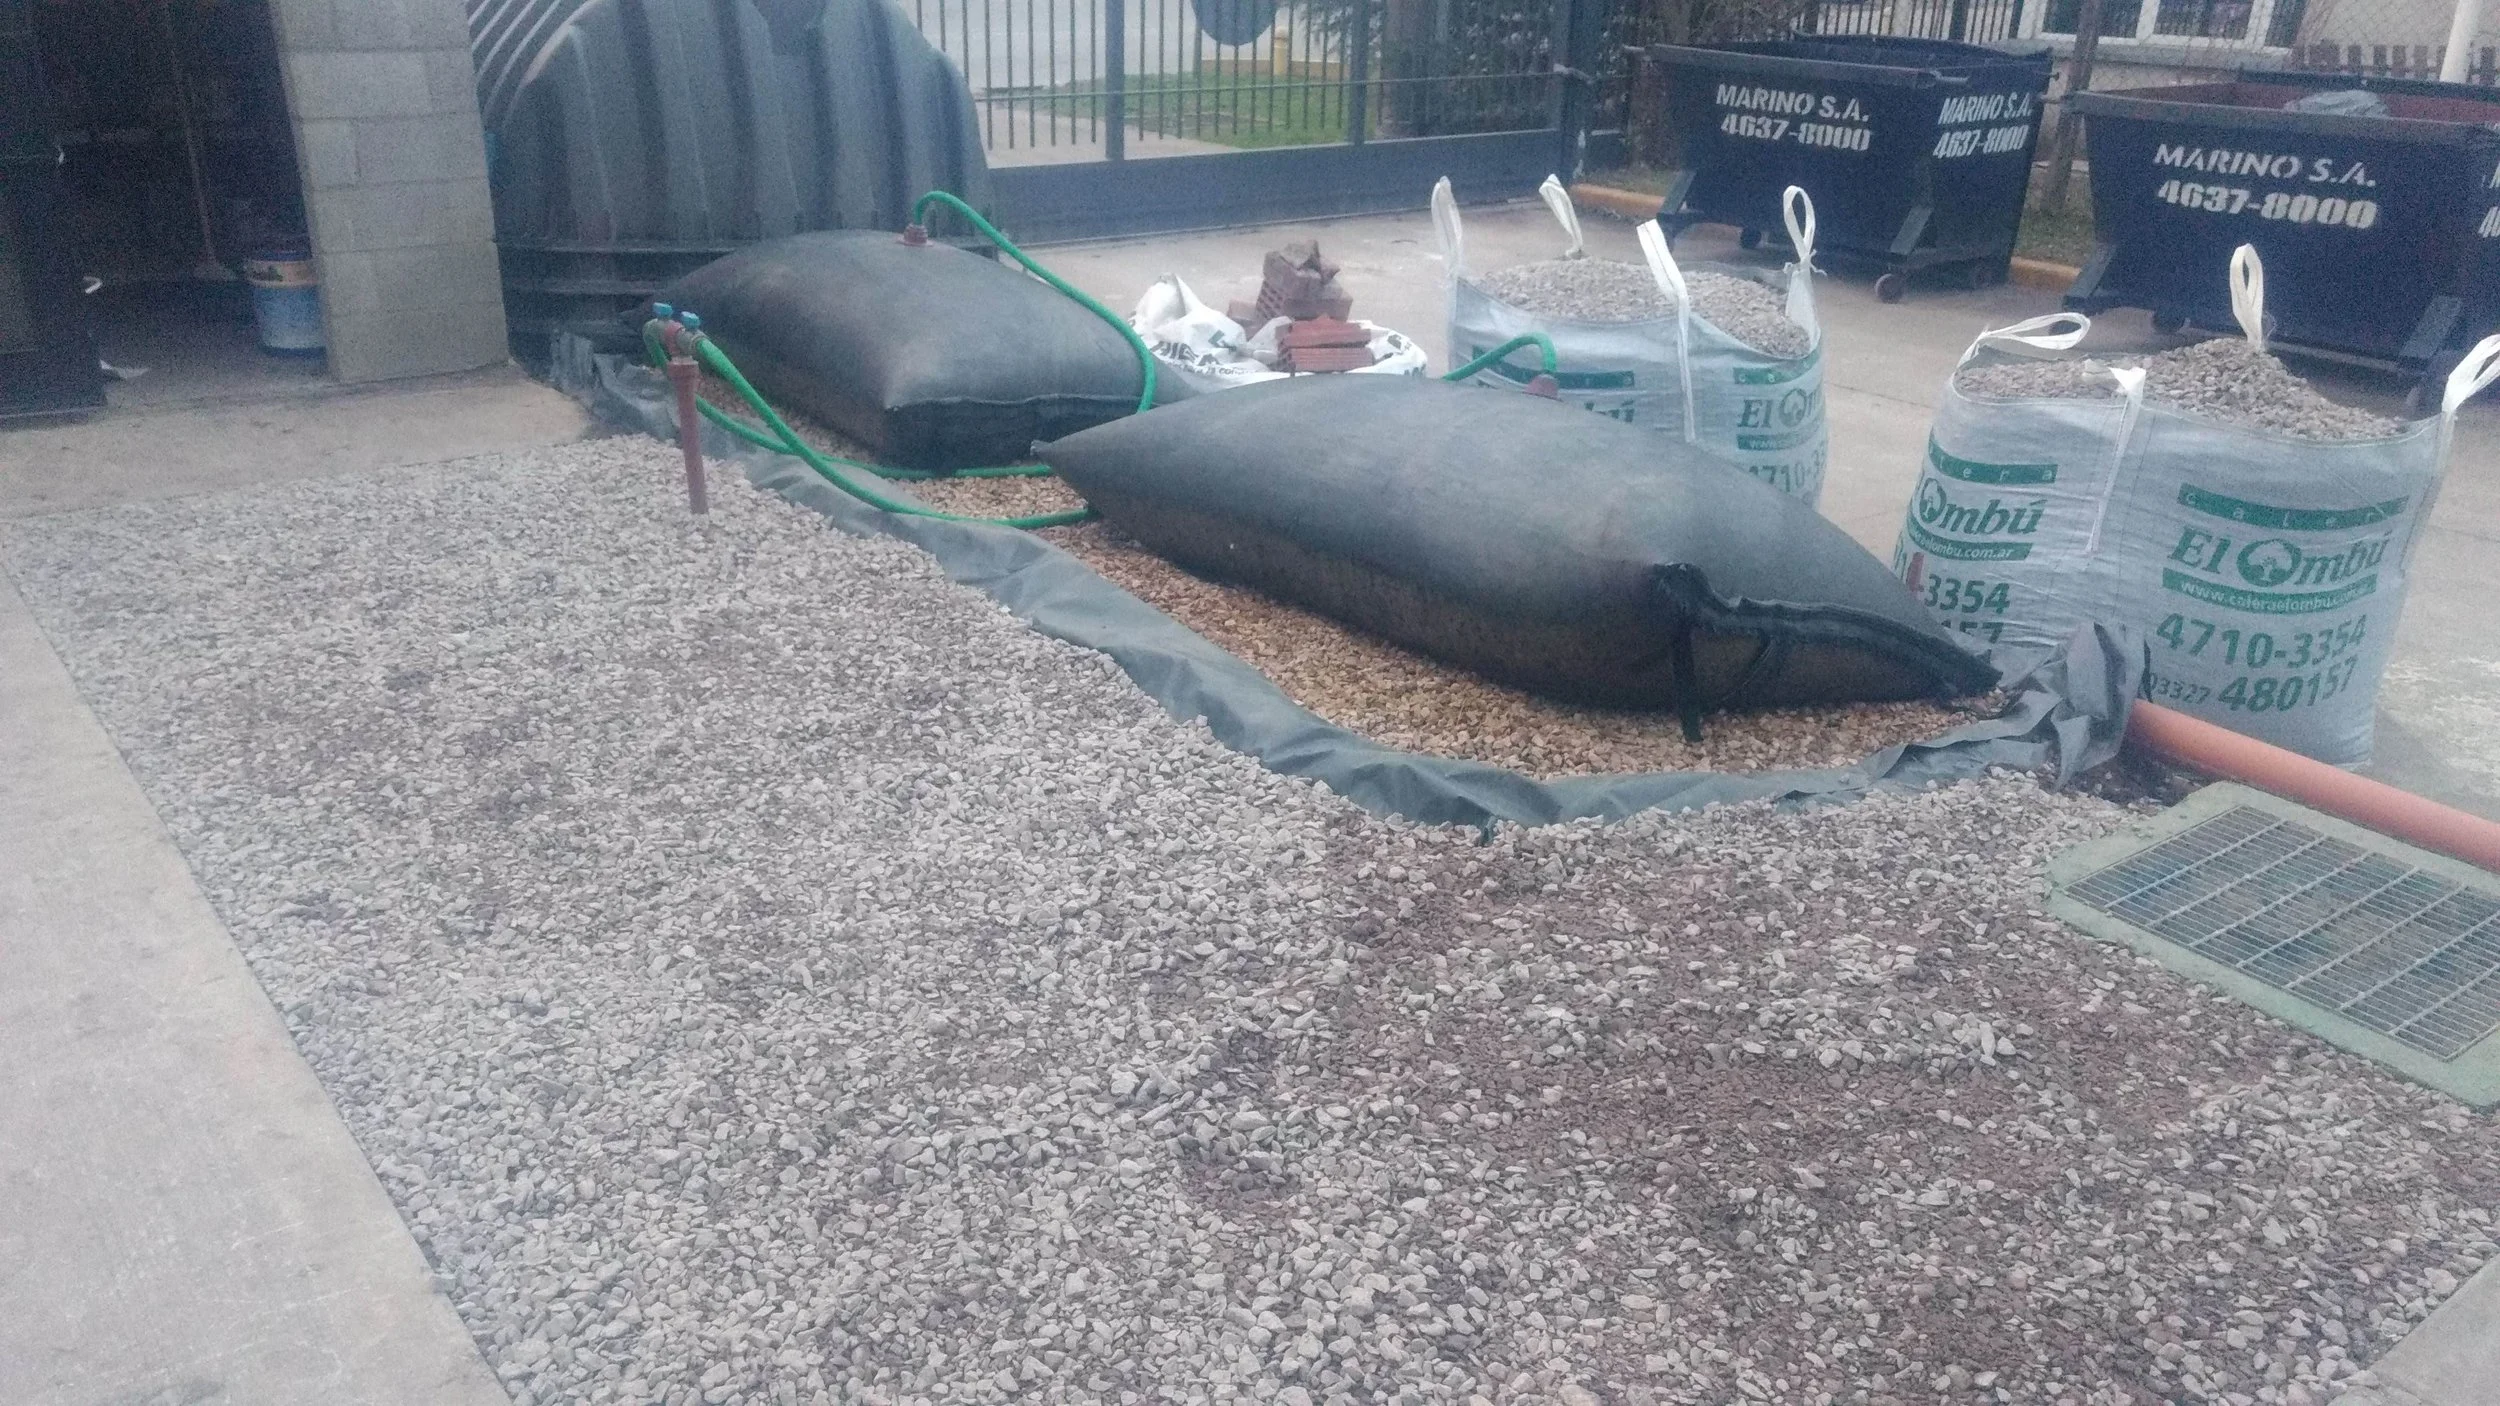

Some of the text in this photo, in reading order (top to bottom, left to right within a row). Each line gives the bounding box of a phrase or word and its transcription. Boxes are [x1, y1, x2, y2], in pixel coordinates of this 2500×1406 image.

[1716, 84, 1870, 122] MARINO S.A.
[1938, 91, 2033, 125] MARINO S.A.
[1720, 113, 1872, 151] 4637-8000
[1932, 125, 2029, 159] 4637-8000
[2154, 143, 2377, 187] MARINO S.A.
[2158, 179, 2378, 229] 4637-8000
[1737, 399, 1772, 429] El
[2167, 525, 2393, 588] El Ombú
[2156, 612, 2367, 669] 4710-3354
[2217, 655, 2358, 713] 480157
